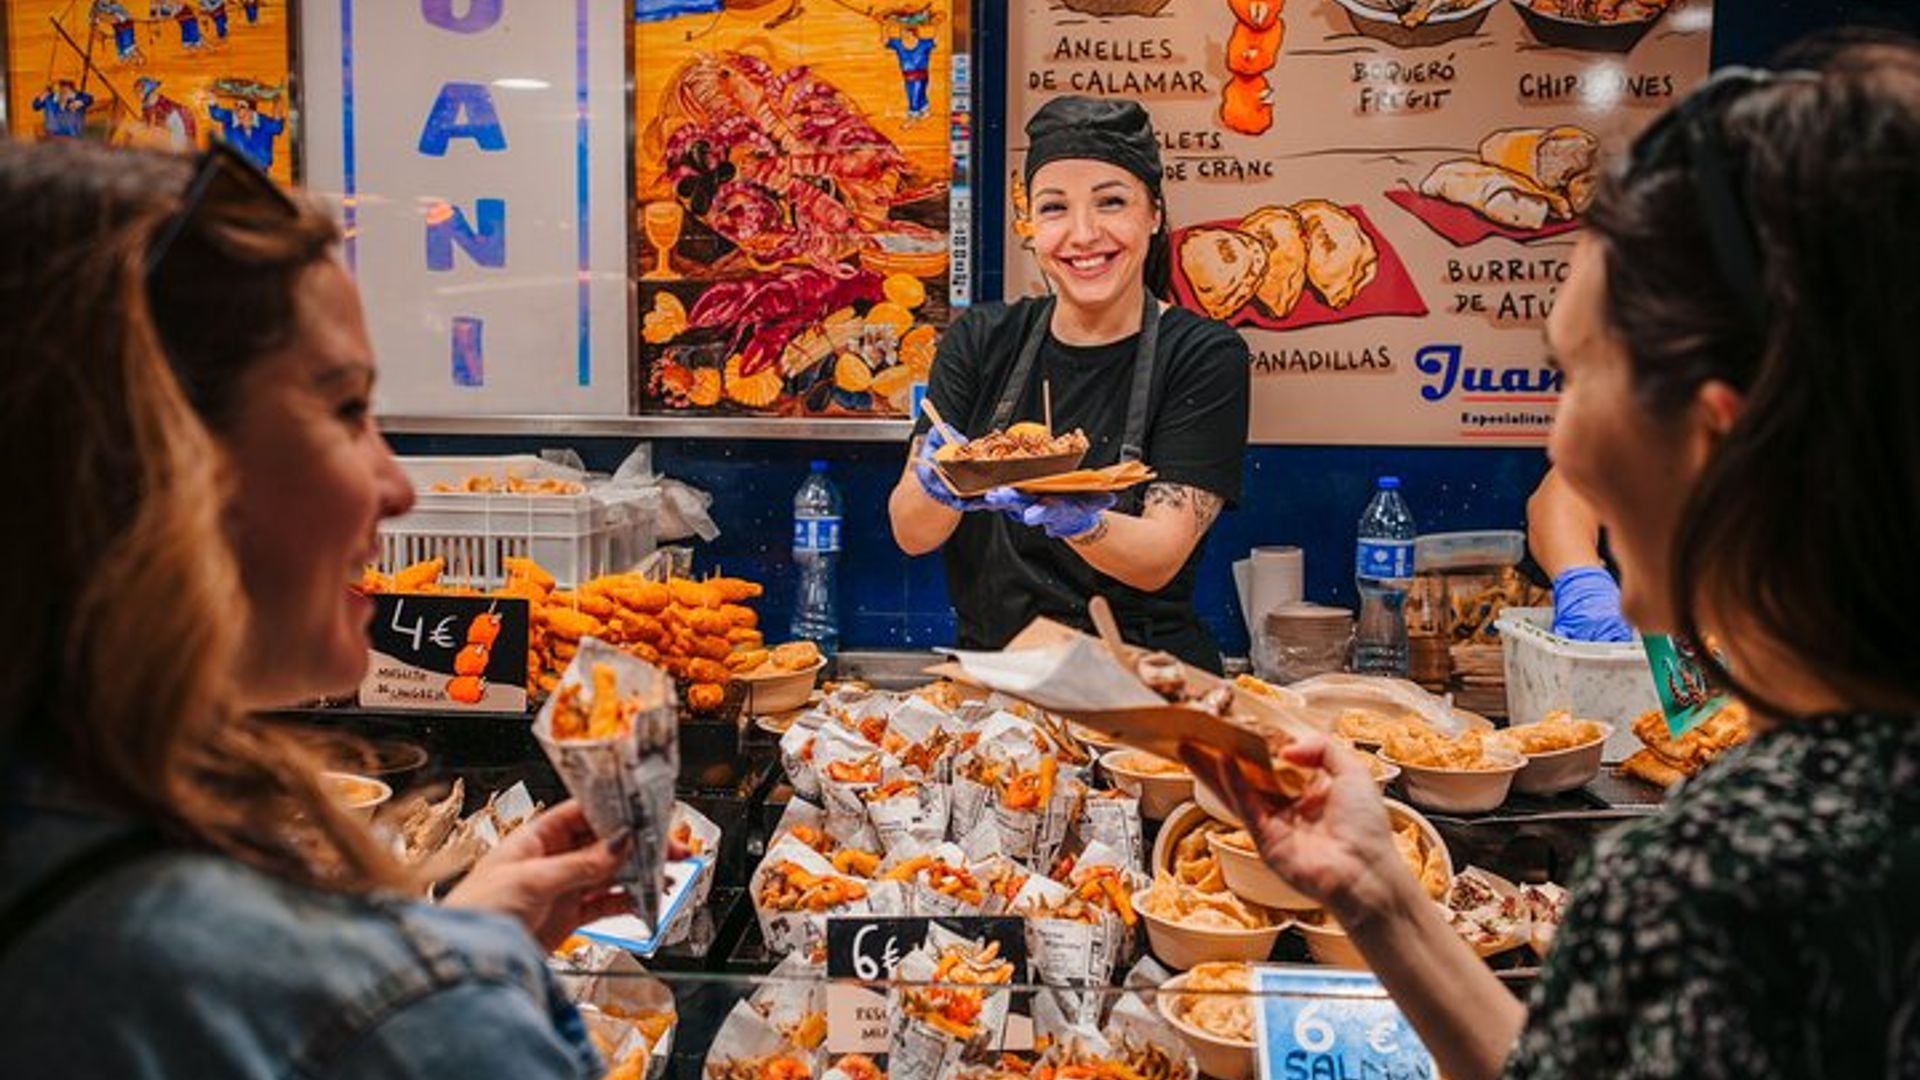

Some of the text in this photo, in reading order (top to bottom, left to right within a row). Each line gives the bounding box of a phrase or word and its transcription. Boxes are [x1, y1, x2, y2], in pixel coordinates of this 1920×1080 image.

[1053, 36, 1173, 63] ANELLES
[1352, 52, 1455, 84] BOQUERÓ
[1028, 70, 1207, 95] DE CALAMAR
[1518, 73, 1674, 99] CHIPNES
[1164, 159, 1274, 181] DE CRANC
[1455, 293, 1487, 313] DE
[1293, 999, 1336, 1054] 6
